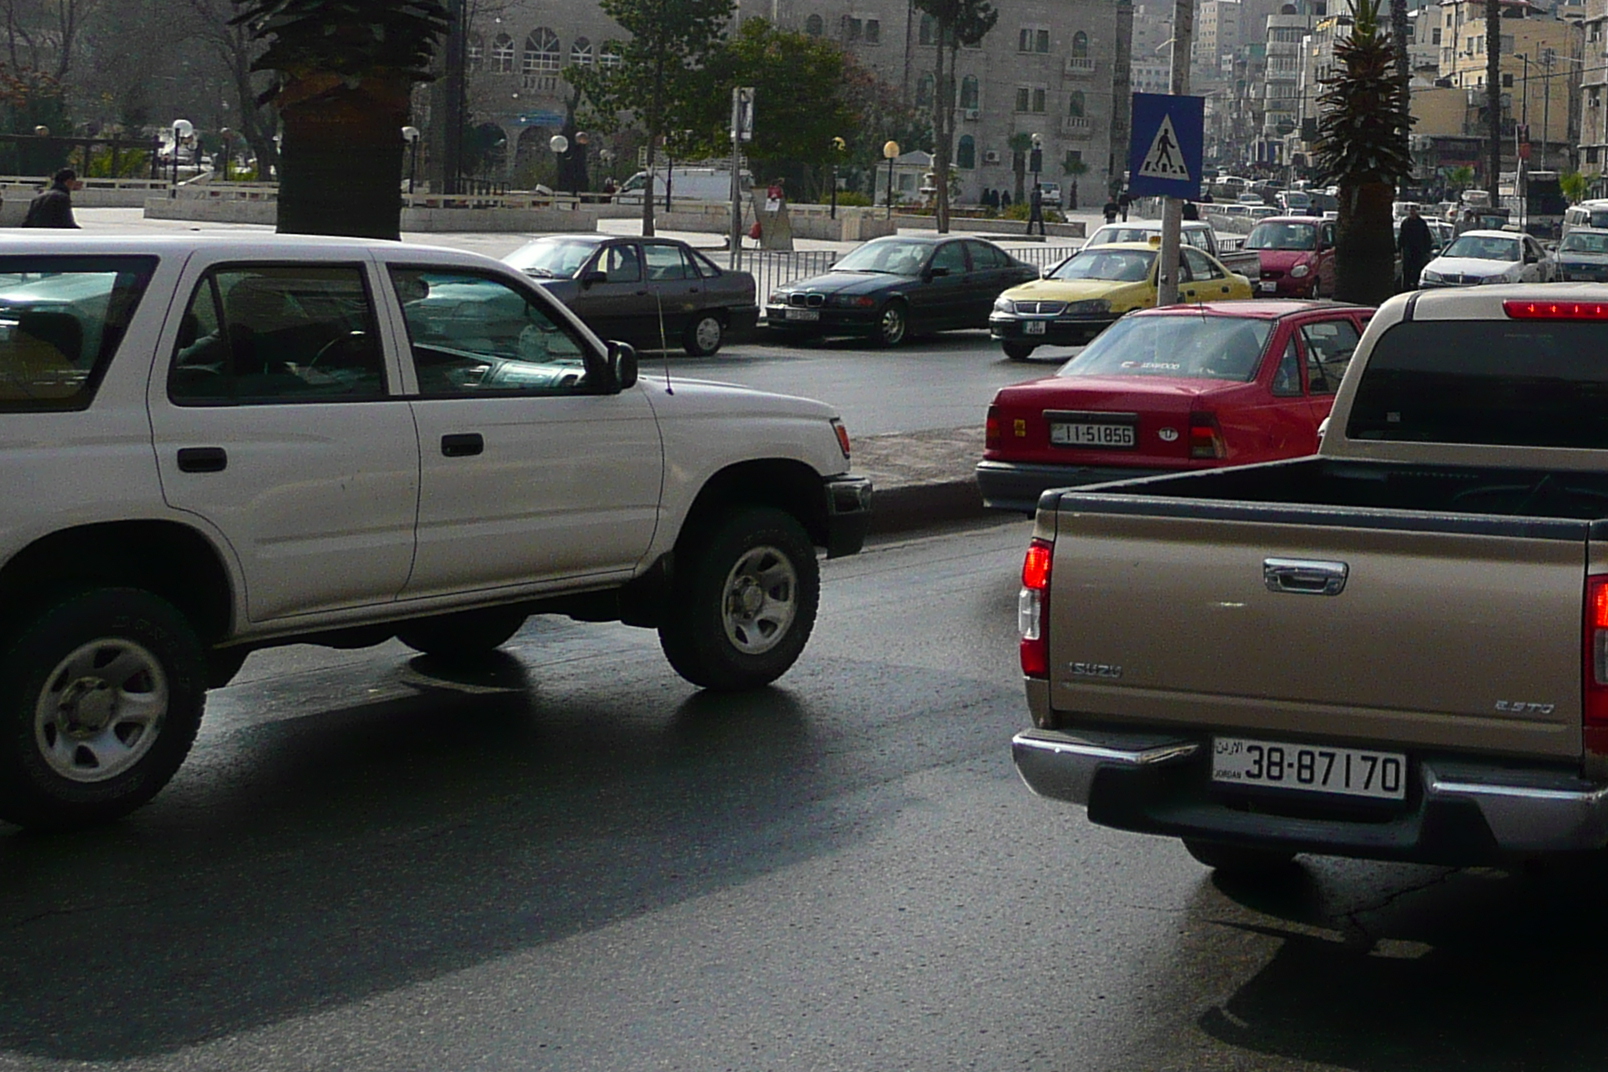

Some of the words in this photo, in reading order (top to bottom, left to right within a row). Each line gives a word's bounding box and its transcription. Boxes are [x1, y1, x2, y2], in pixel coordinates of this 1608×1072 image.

[1069, 662, 1122, 678] ISUZU
[1216, 741, 1243, 756] الاردن
[1215, 769, 1242, 779] JORDAN
